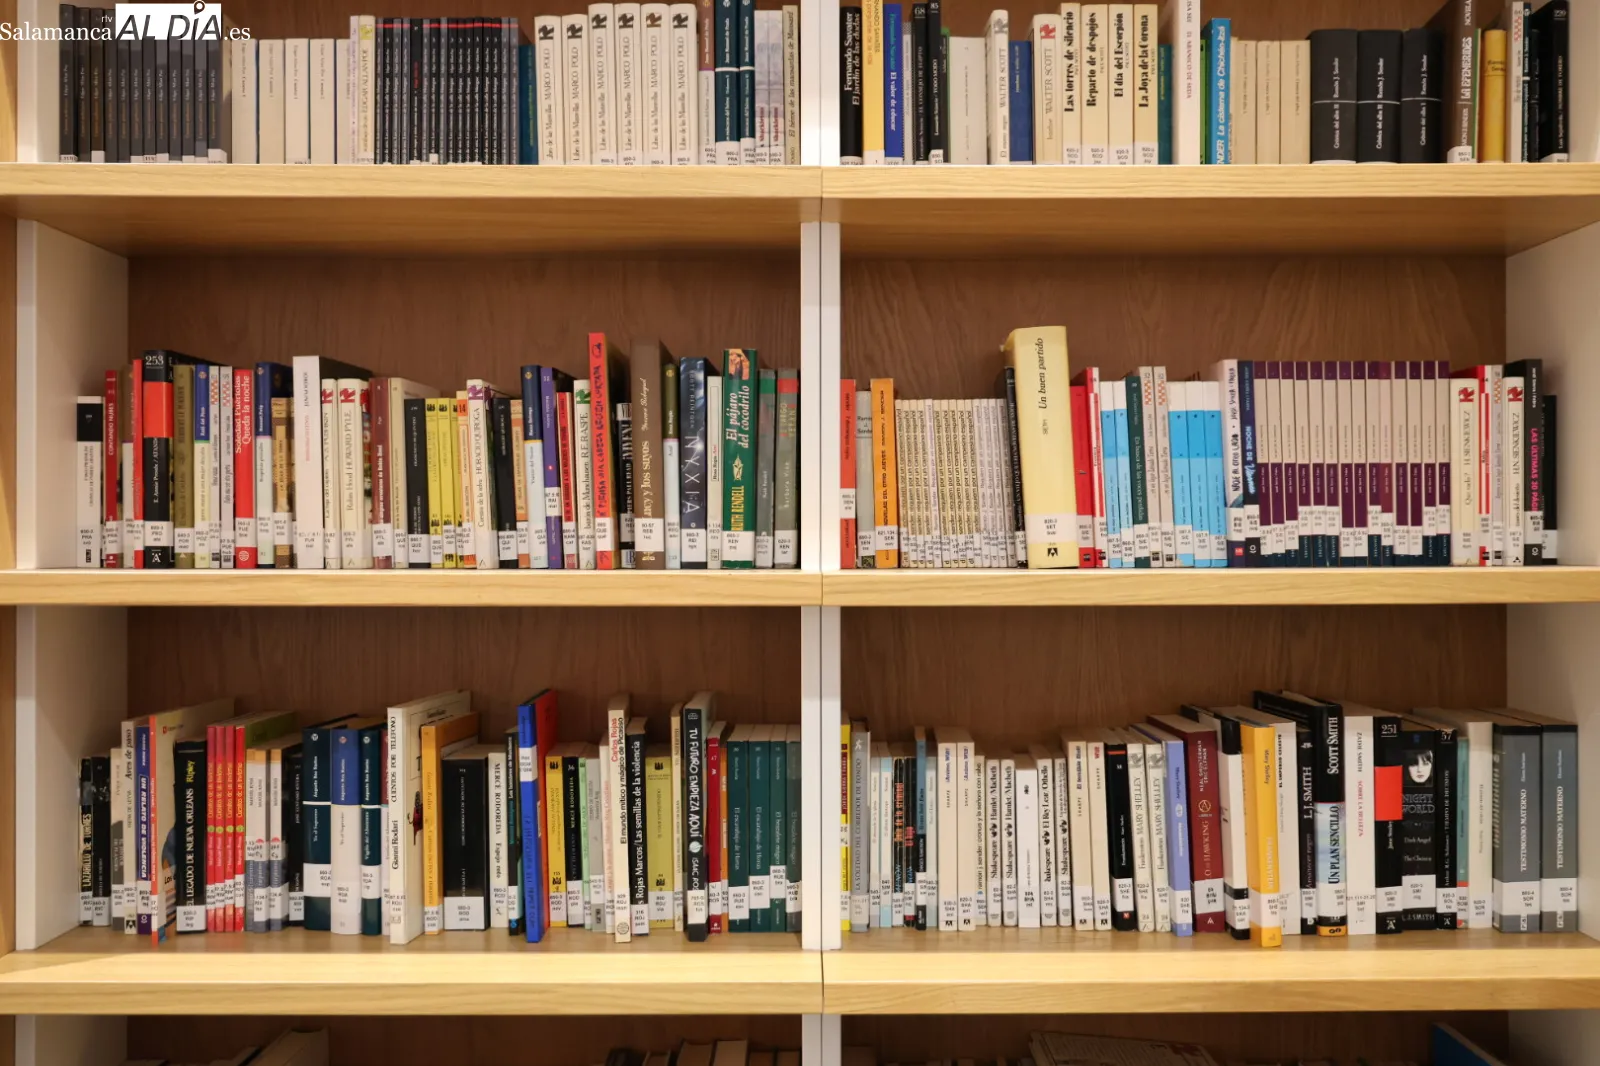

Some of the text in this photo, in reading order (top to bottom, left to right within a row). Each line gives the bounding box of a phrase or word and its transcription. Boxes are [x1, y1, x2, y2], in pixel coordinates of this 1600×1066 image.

[844, 13, 853, 90] Fernando Savater
[853, 56, 860, 68] de
[1064, 12, 1074, 112] Las torres de silencio
[1087, 13, 1098, 107] Reparto de despojos
[1114, 13, 1124, 97] El día del Escorpión
[1138, 15, 1151, 107] La Joya de la Corona
[853, 72, 861, 95] jardín
[1461, 88, 1471, 99] LA
[853, 96, 860, 105] El
[1035, 338, 1047, 409] Un buen partido
[241, 376, 250, 402] noche
[242, 415, 251, 444] Queda
[726, 392, 739, 440] El pájaro
[739, 386, 750, 448] del cocodrilo
[641, 441, 652, 470] suyos
[641, 473, 650, 488] los
[684, 436, 700, 514] NYXIA
[731, 486, 744, 530] RUTH RENDELL
[1135, 496, 1144, 520] perdidas
[125, 729, 134, 748] paso
[611, 718, 620, 738] Rojas
[125, 750, 132, 759] de
[618, 746, 626, 755] de
[632, 741, 642, 776] violencia
[1328, 717, 1338, 774] SCOTT SMITH
[141, 777, 147, 788] UN
[186, 760, 196, 782] Ripley
[619, 757, 628, 782] mágico
[688, 728, 702, 838] TU FUTURO EMPIEZA AQUÍ
[633, 787, 642, 796] de
[855, 786, 861, 795] DE
[1134, 777, 1143, 811] SHELLEY
[1303, 766, 1312, 801] SMITH
[185, 788, 194, 824] ORLEANS
[1358, 802, 1363, 810] LA
[1402, 793, 1433, 803] NIGHT
[633, 797, 642, 828] semillas
[1136, 812, 1144, 834] MARY
[141, 824, 147, 835] DE
[186, 825, 194, 851] NUEVA
[1202, 821, 1210, 861] HAWKING
[82, 814, 92, 887] LAZARILLO DE TORMES
[186, 853, 194, 864] DE
[1060, 837, 1068, 875] Shakespeare
[1328, 806, 1340, 884] UN PLAN SENCILLO
[186, 866, 195, 897] LEGADO
[636, 877, 646, 898] Rojas
[855, 882, 861, 890] LA
